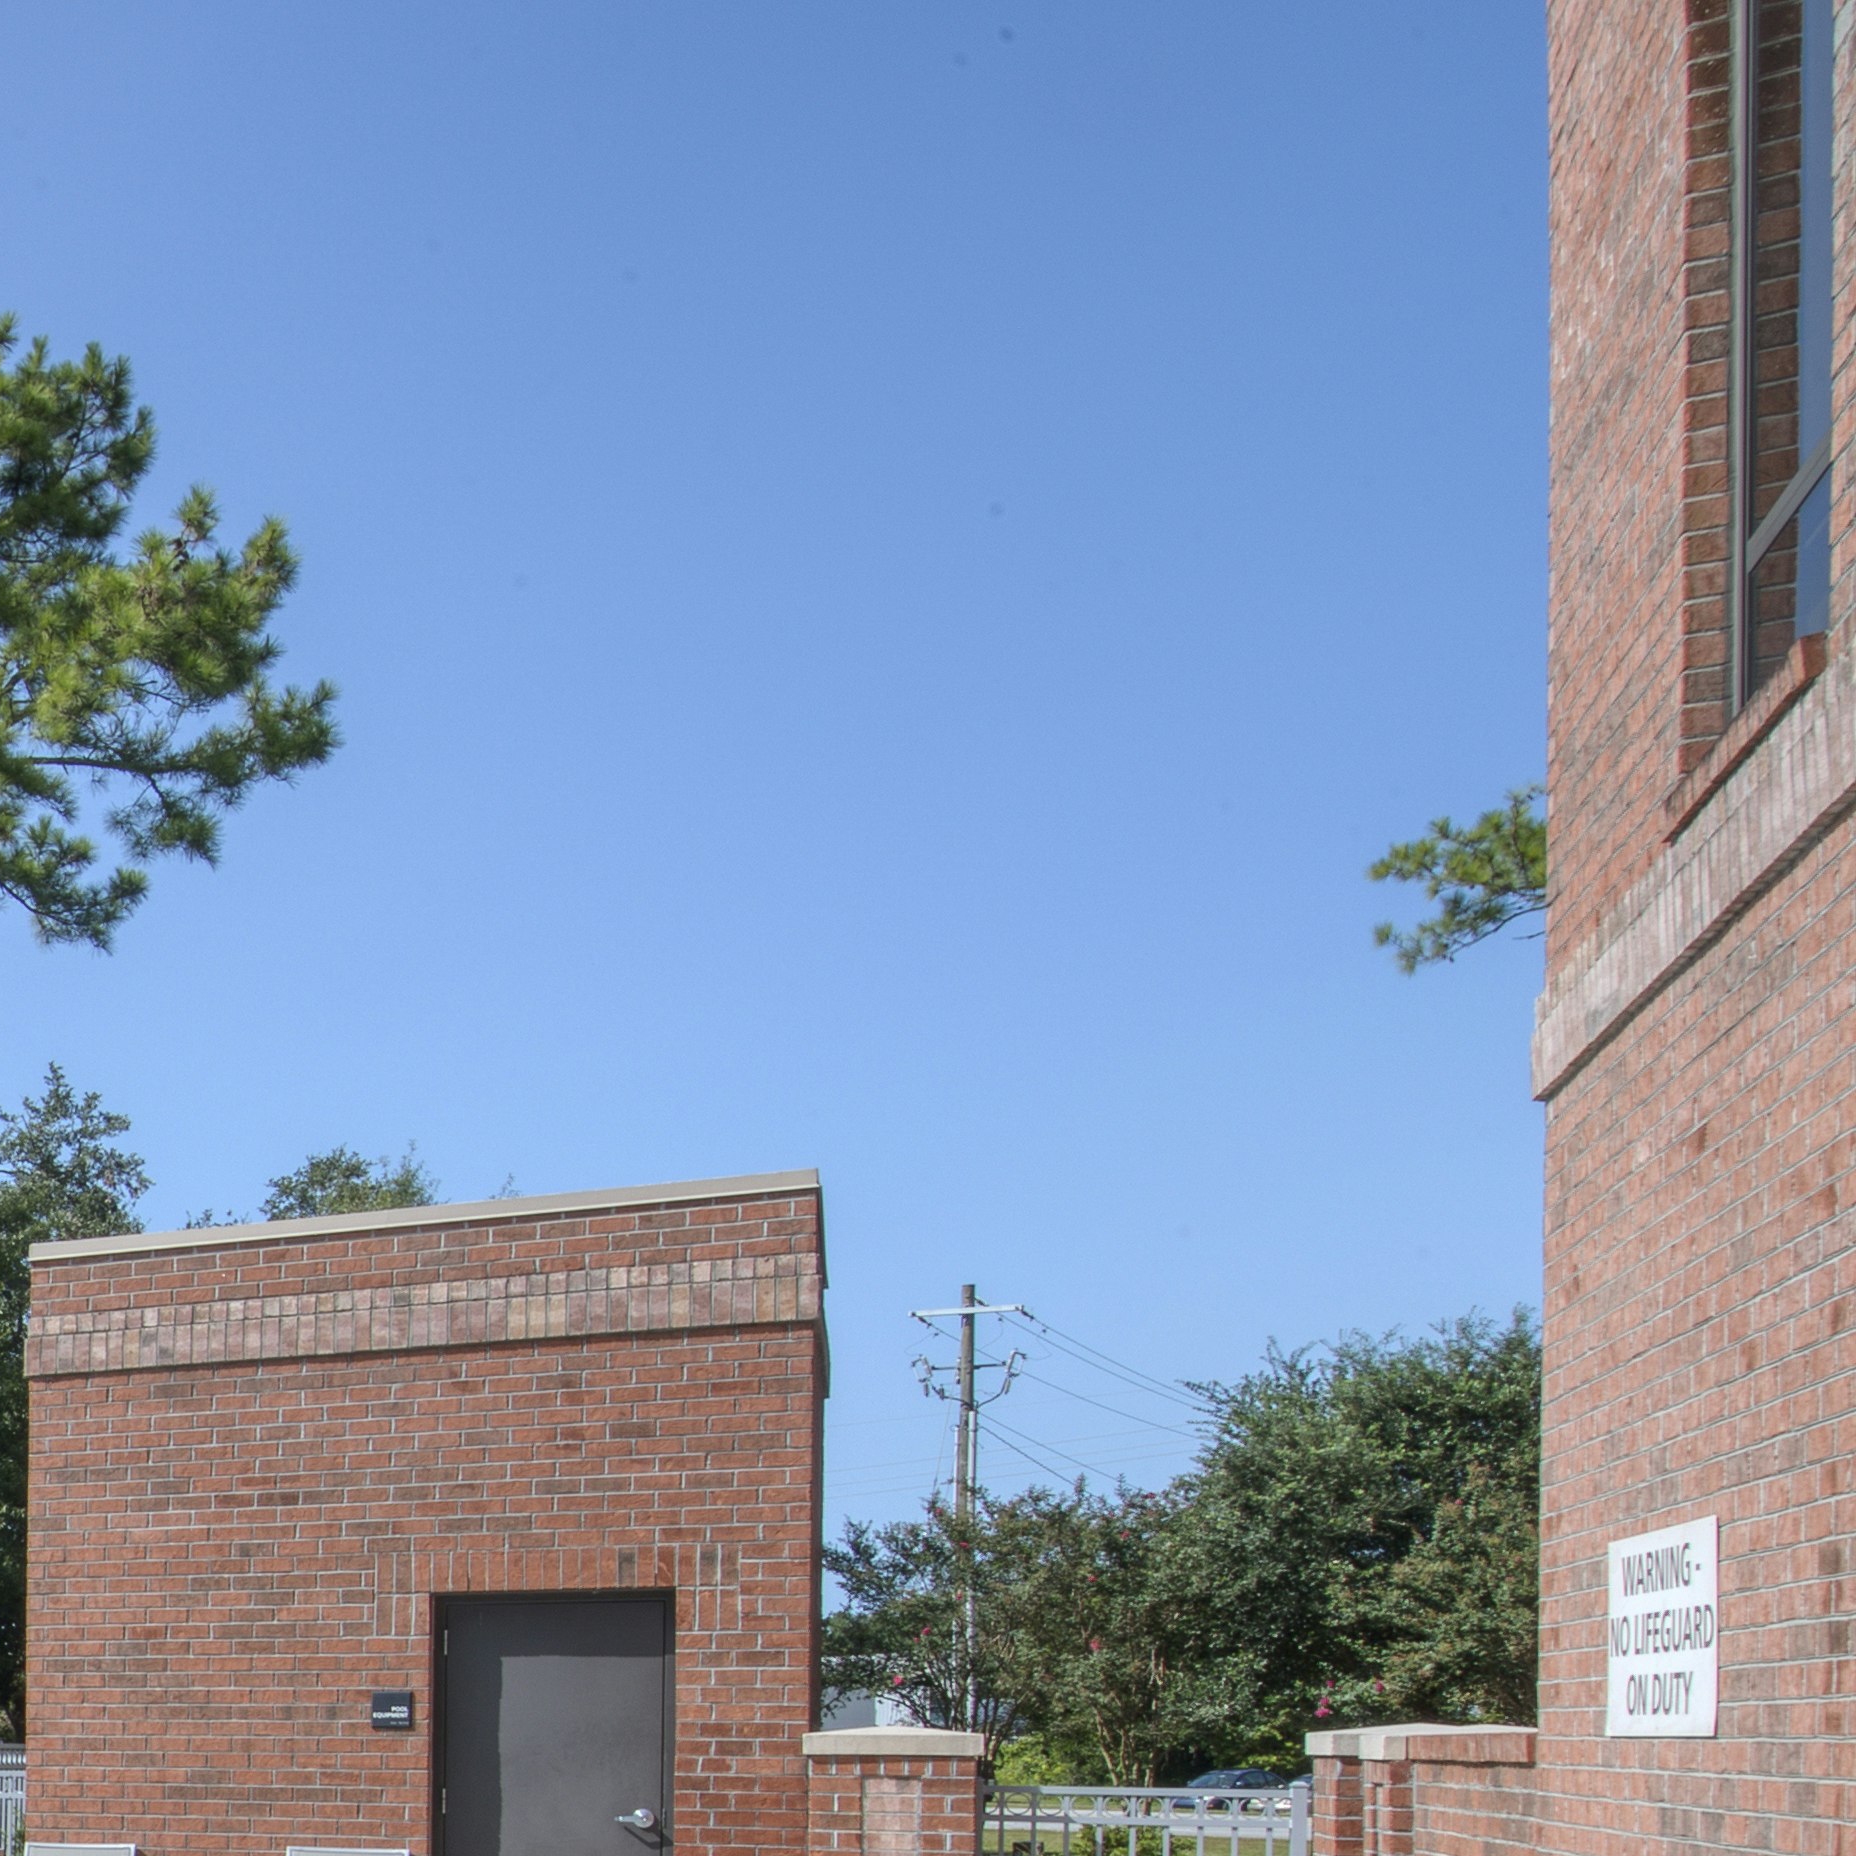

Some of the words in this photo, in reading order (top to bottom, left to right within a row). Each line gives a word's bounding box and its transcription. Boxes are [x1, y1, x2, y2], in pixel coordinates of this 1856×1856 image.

[1621, 1542, 1691, 1596] WARNING
[1610, 1616, 1631, 1657] NO
[1634, 1604, 1715, 1655] LIFEGUARD
[1626, 1674, 1648, 1716] ON
[1651, 1671, 1693, 1715] DUTY
